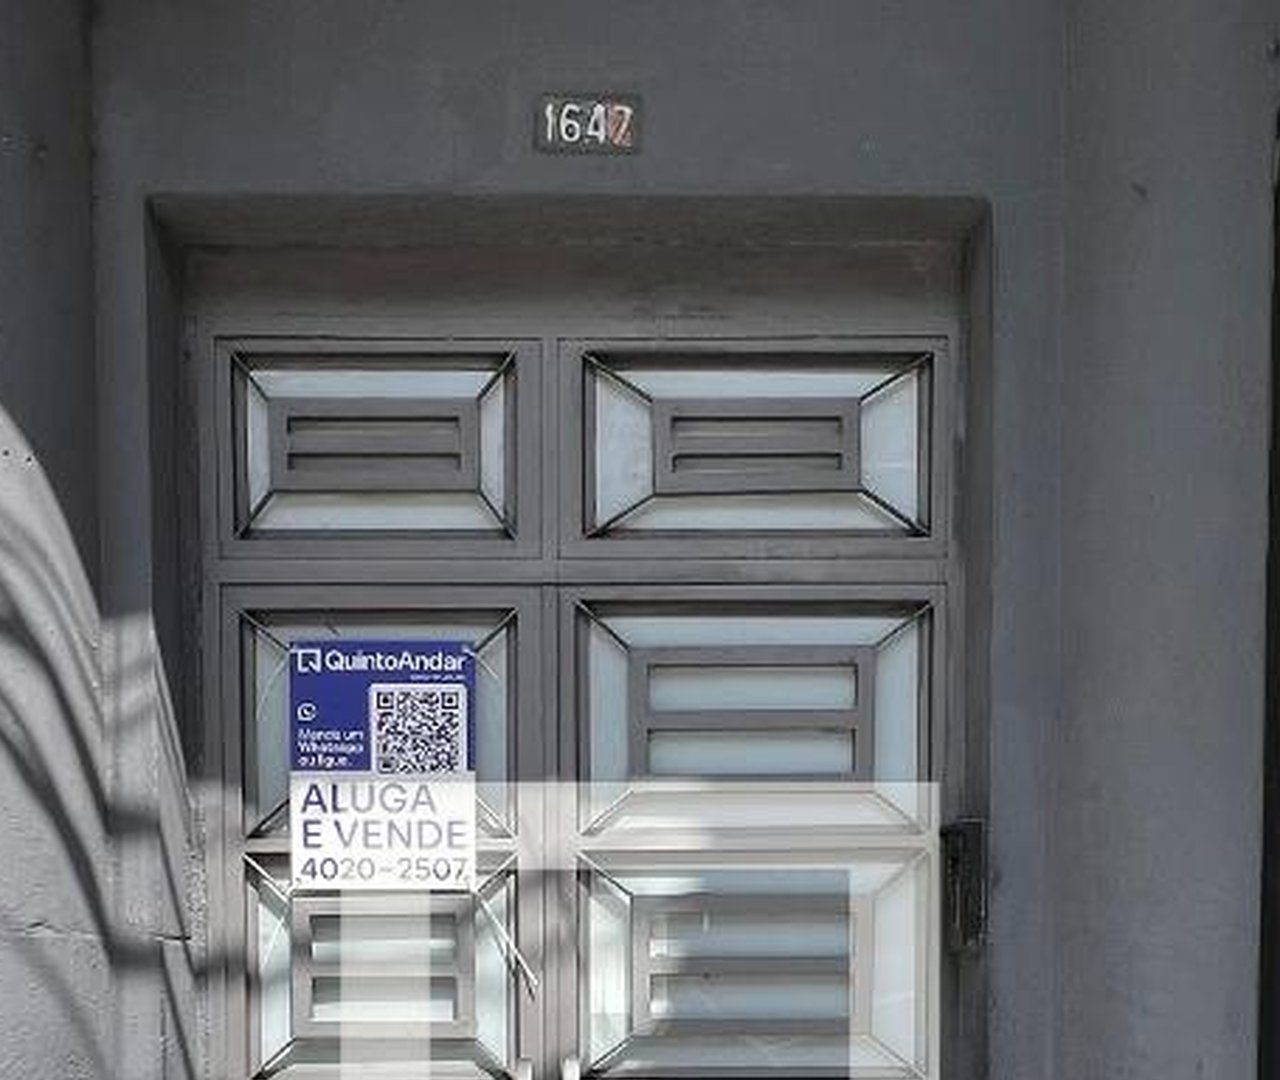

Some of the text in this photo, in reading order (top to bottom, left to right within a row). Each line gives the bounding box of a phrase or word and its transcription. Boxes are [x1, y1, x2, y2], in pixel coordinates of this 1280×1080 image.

[325, 650, 467, 672] QuintoAndar
[301, 783, 437, 814] ALUGA
[303, 820, 468, 849] E VENDE
[301, 857, 468, 881] 4020-2507
